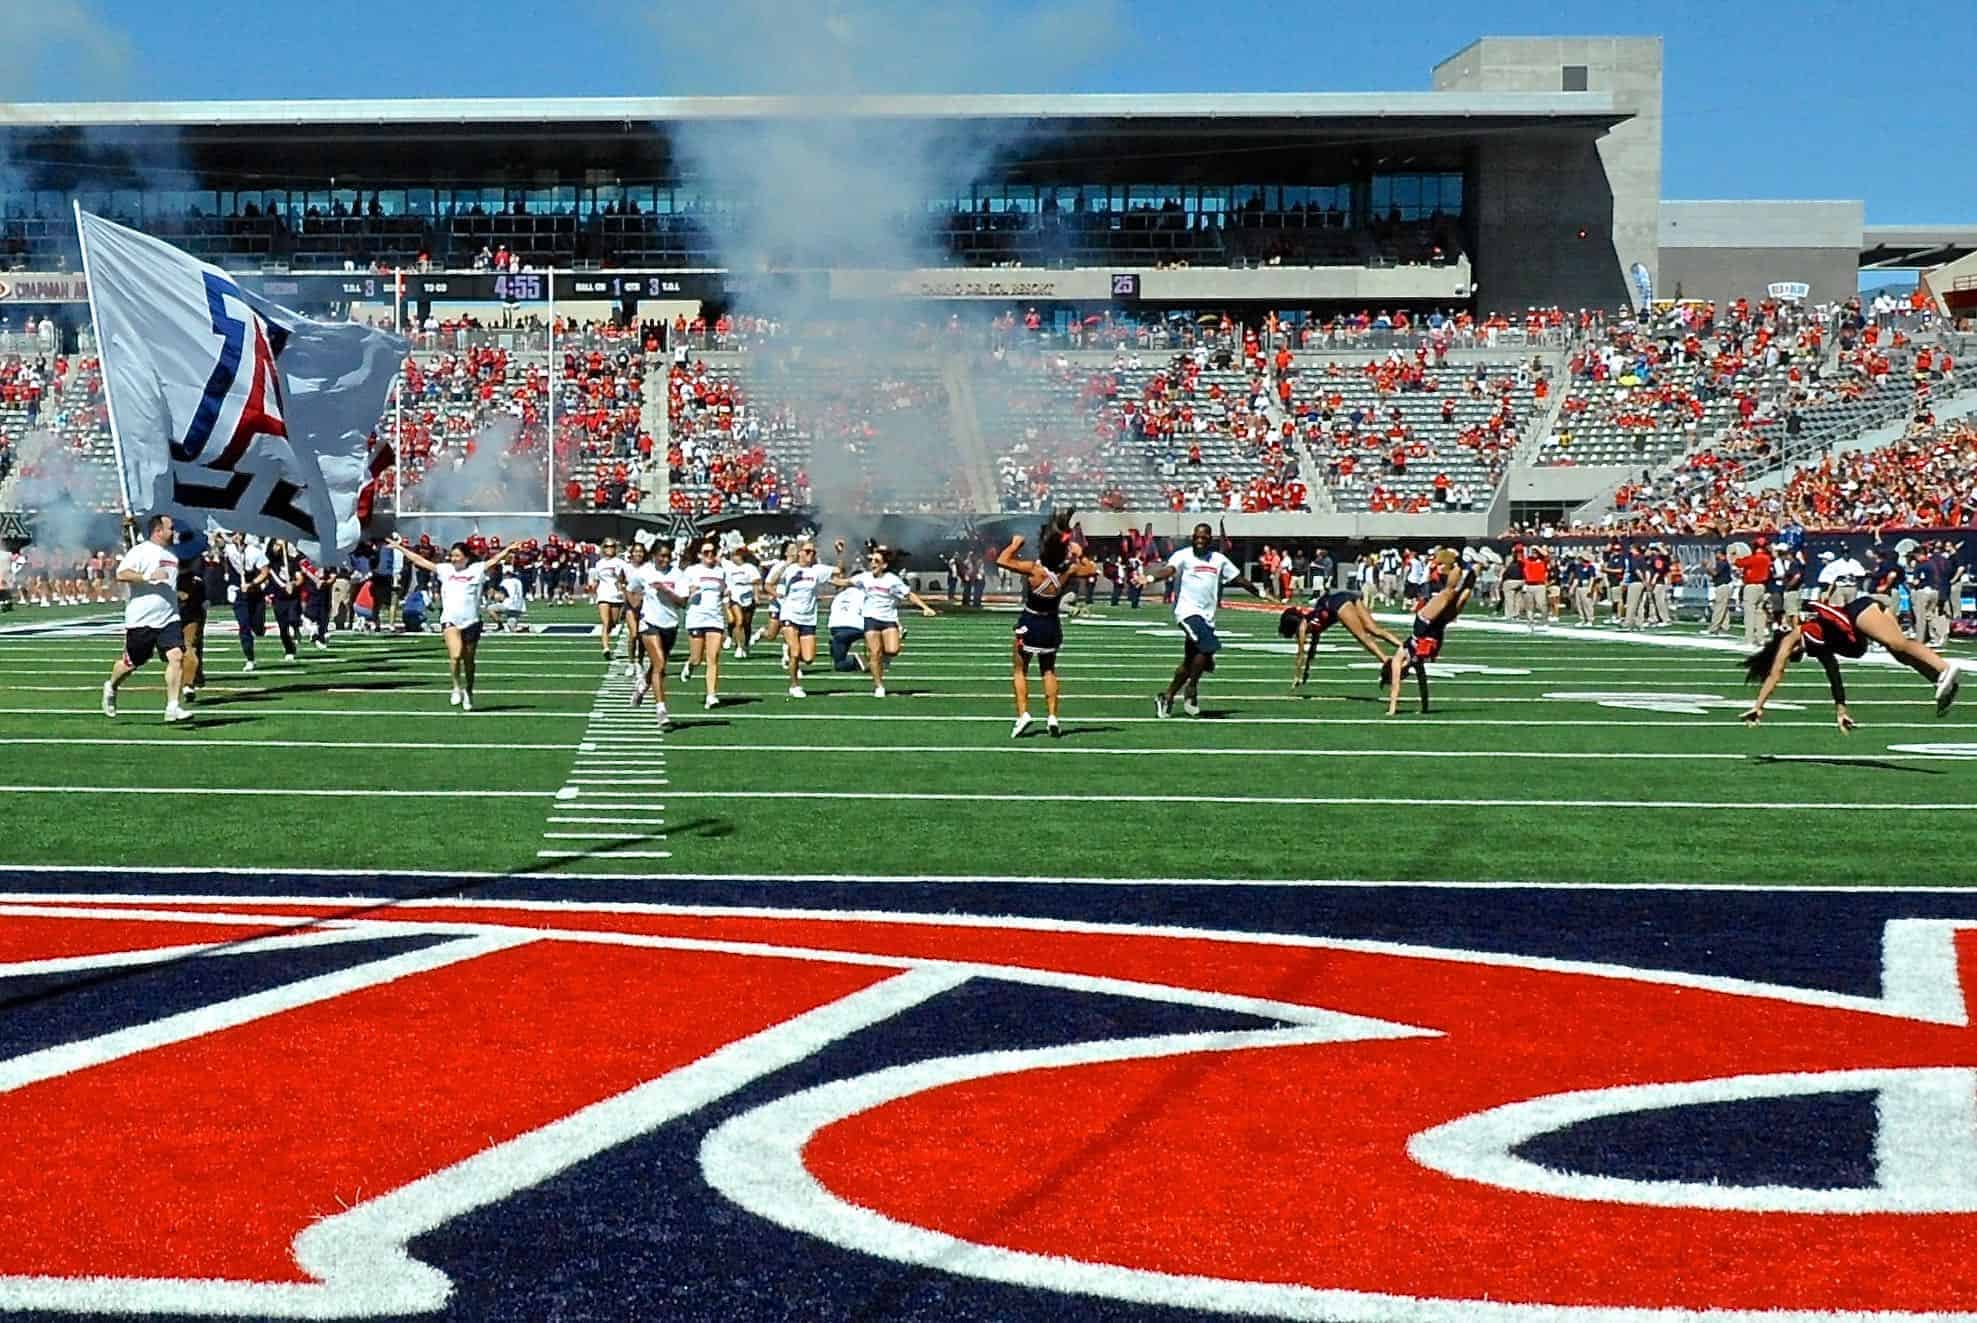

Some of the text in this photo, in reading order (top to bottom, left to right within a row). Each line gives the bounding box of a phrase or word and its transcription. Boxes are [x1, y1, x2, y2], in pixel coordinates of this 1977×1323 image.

[15, 281, 68, 298] CHAPMAN
[494, 275, 540, 299] 4:55
[648, 278, 659, 296] 3
[1113, 275, 1133, 294] 25
